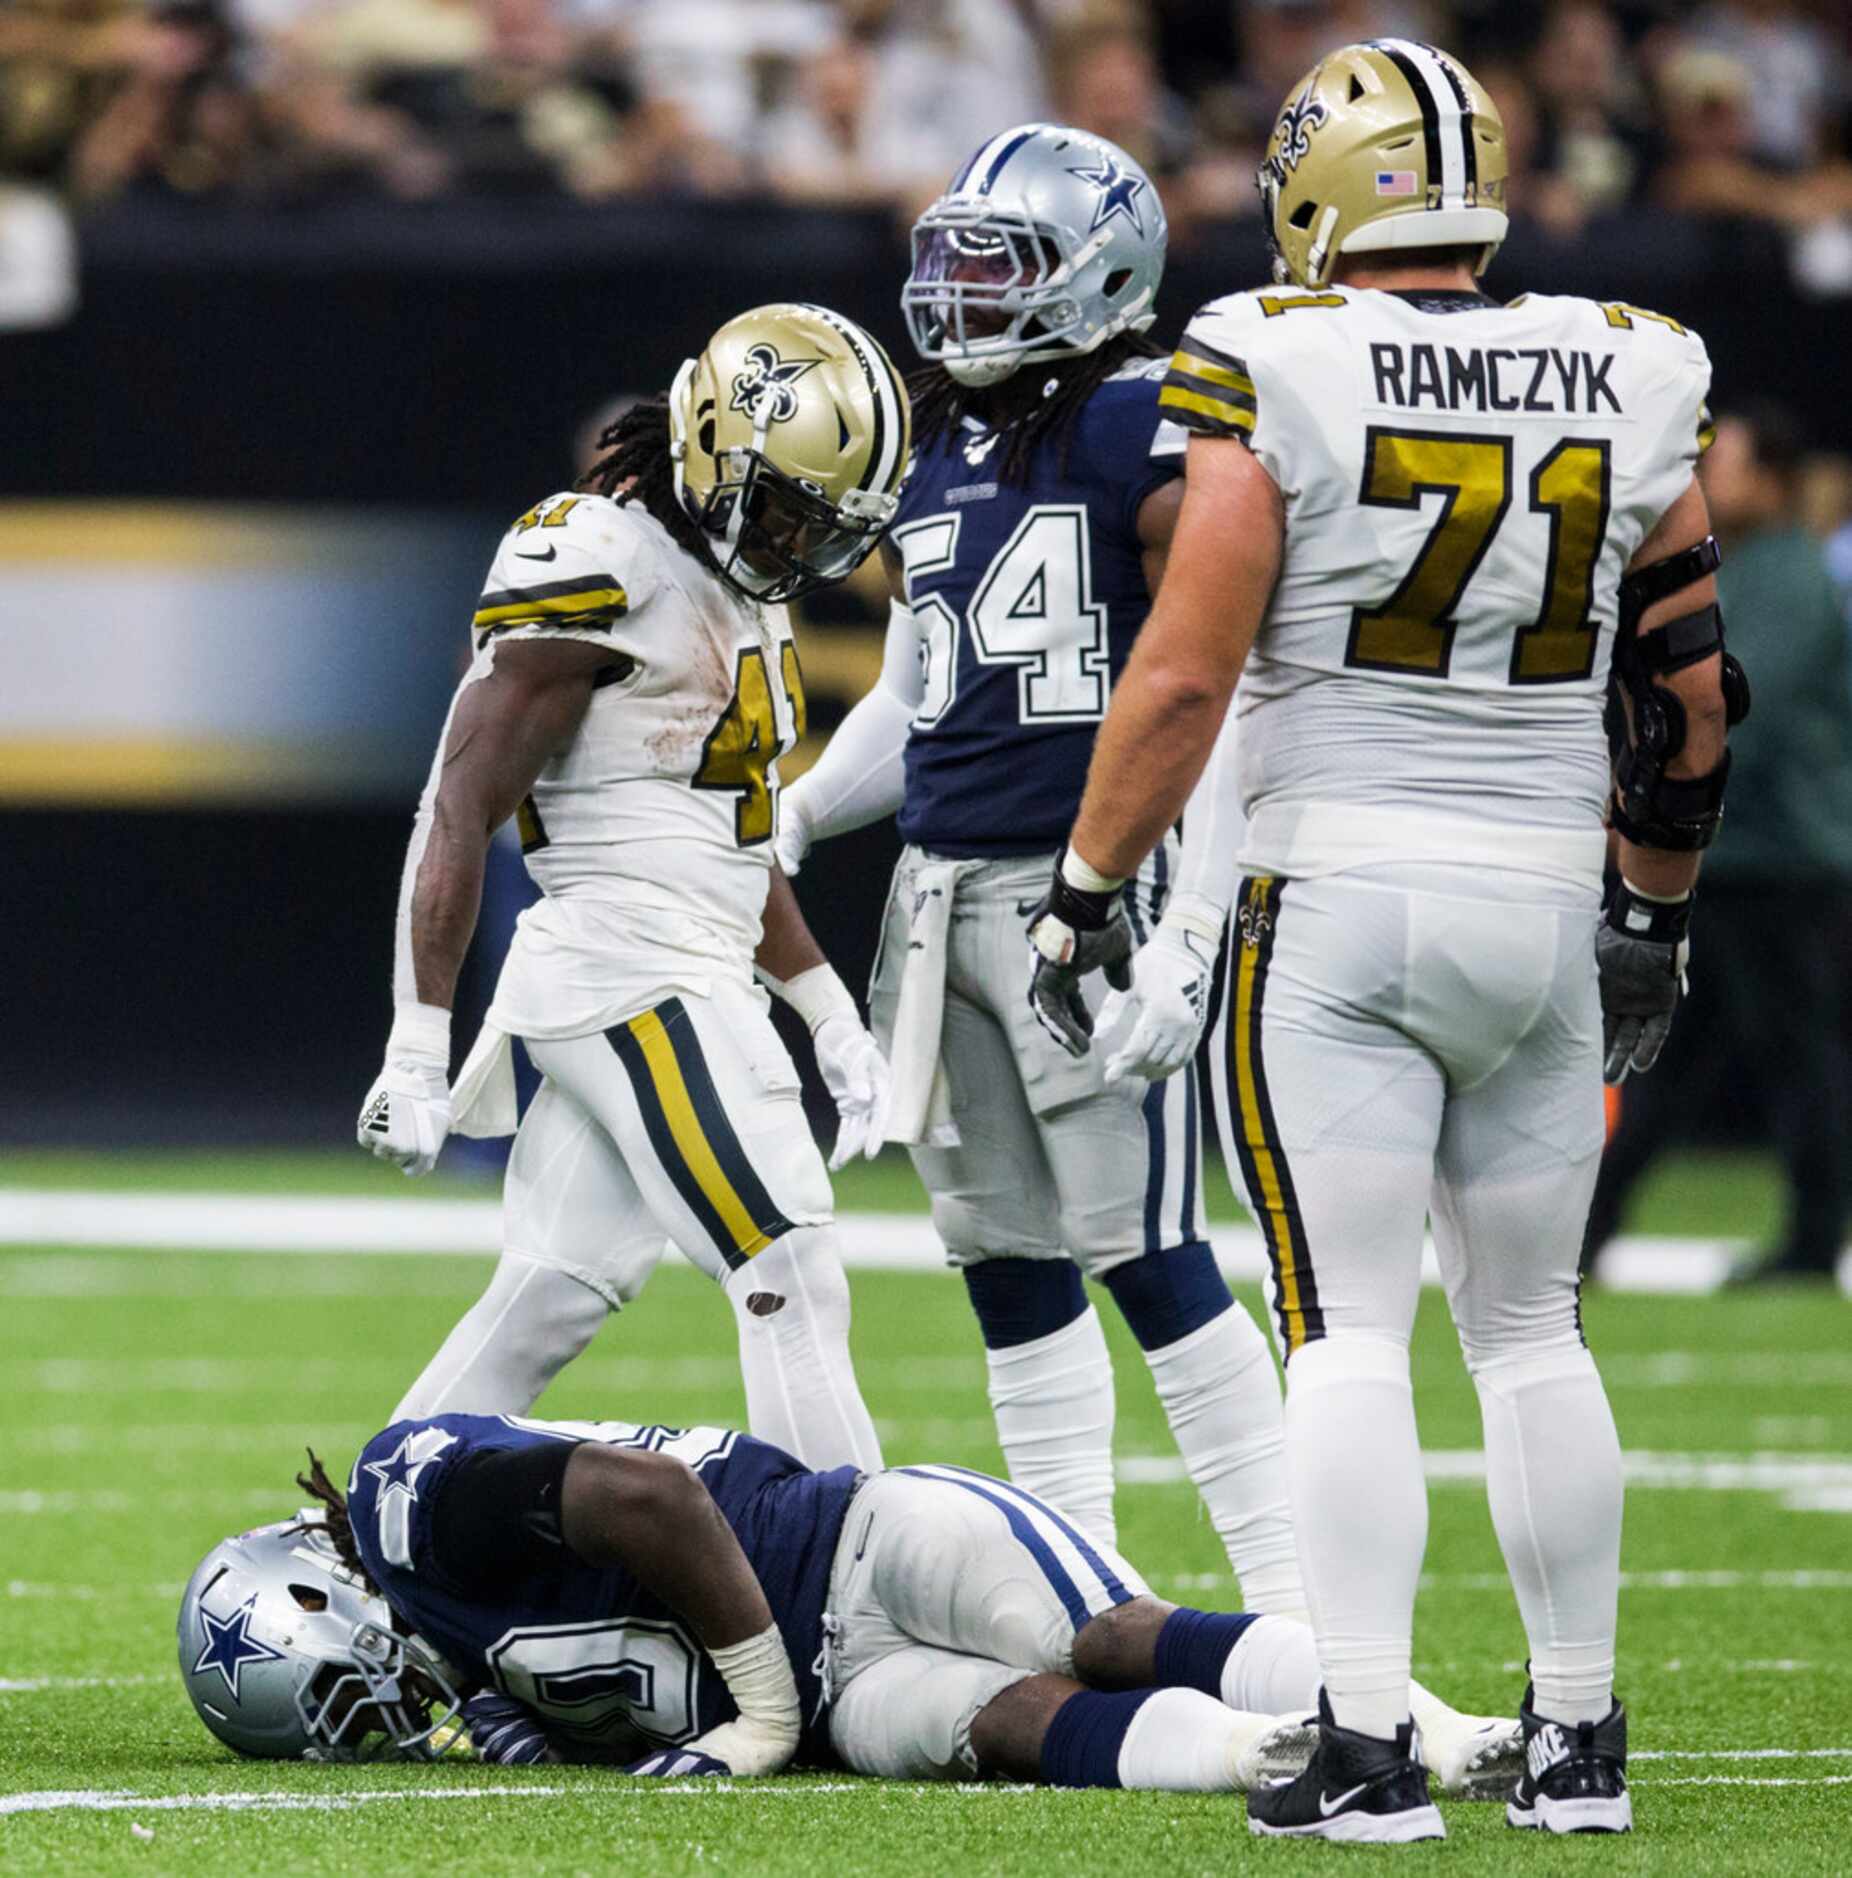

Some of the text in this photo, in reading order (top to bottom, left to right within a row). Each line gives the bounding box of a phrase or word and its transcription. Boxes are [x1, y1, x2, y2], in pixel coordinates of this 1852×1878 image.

[1369, 342, 1623, 414] RAMCZYK
[889, 504, 1109, 730] 54
[1344, 425, 1612, 686] 71
